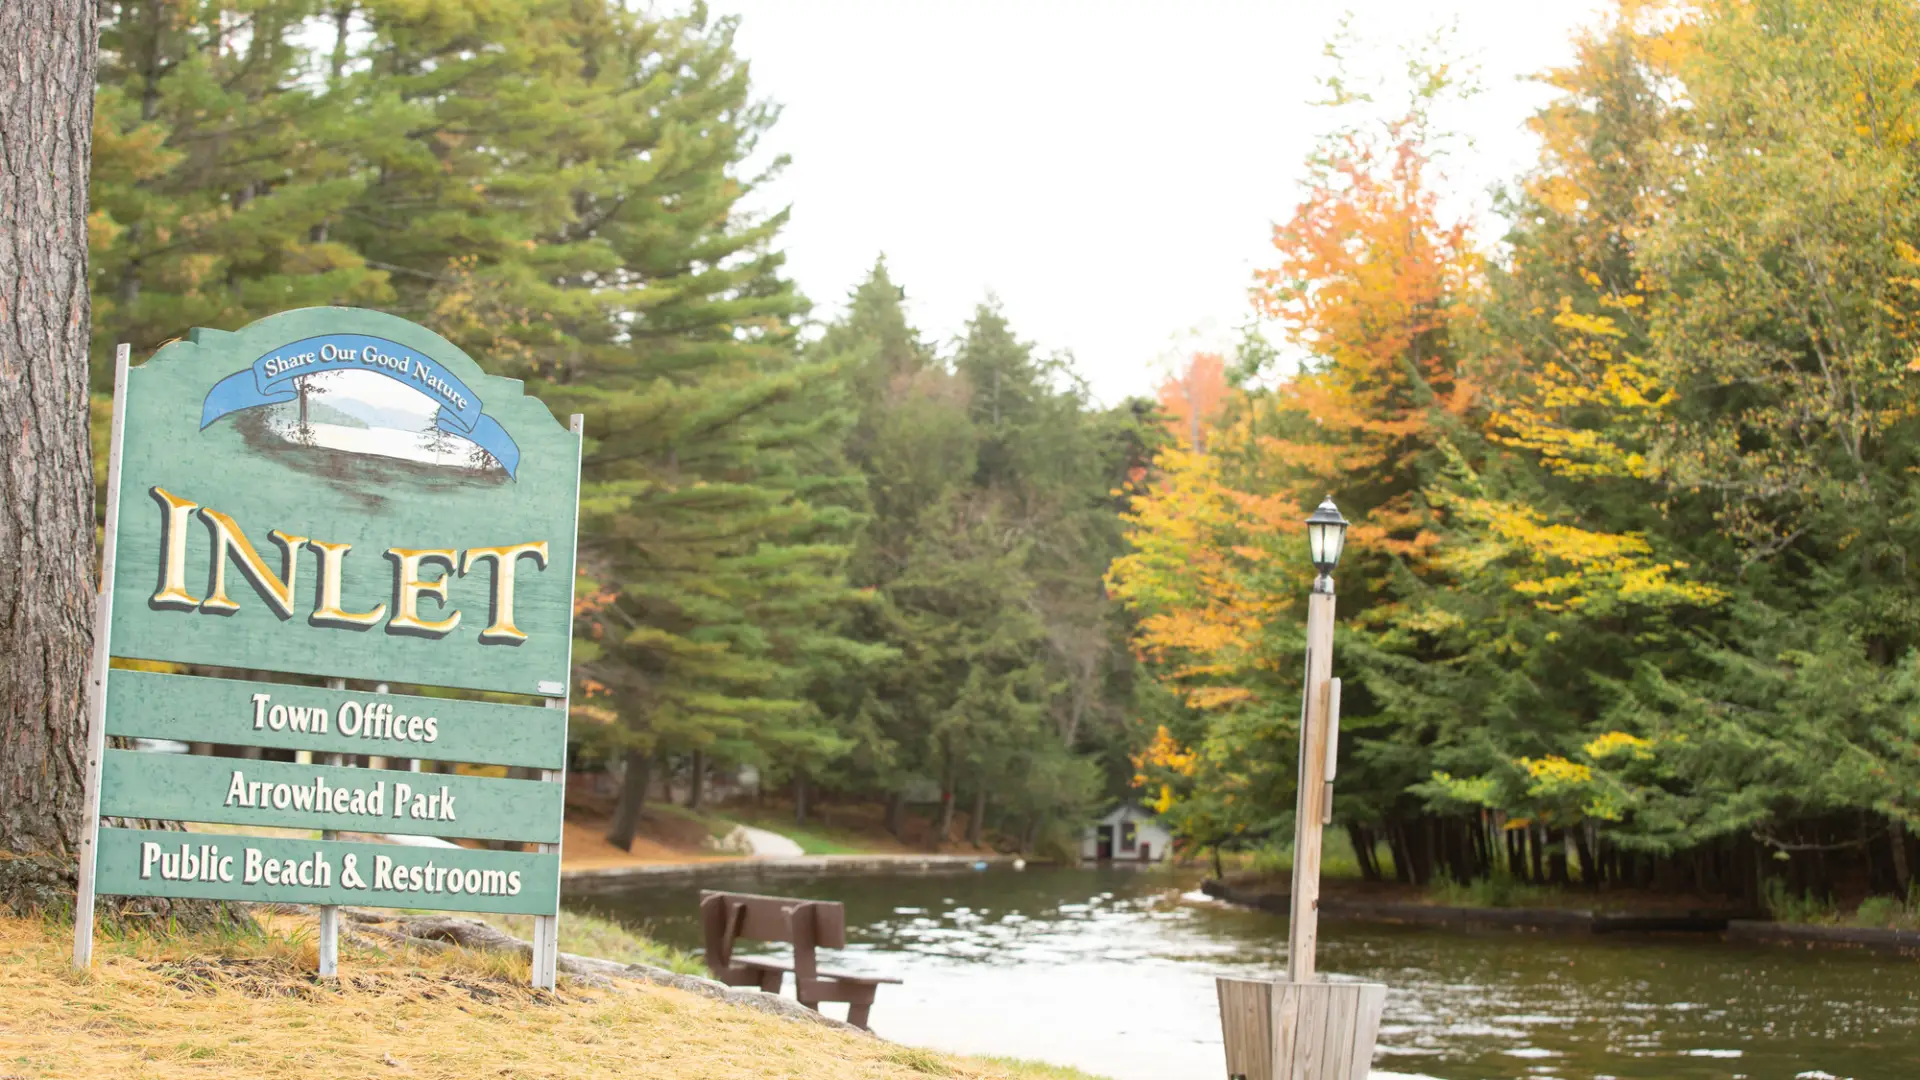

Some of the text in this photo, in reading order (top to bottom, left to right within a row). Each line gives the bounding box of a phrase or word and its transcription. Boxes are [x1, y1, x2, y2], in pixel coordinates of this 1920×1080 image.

[264, 343, 468, 411] Share Our Good Nature
[148, 486, 549, 646] INLET
[251, 693, 438, 743] Town Offices
[225, 771, 456, 821] Arrowhead Park
[141, 842, 522, 897] Public Beach & Restrooms
